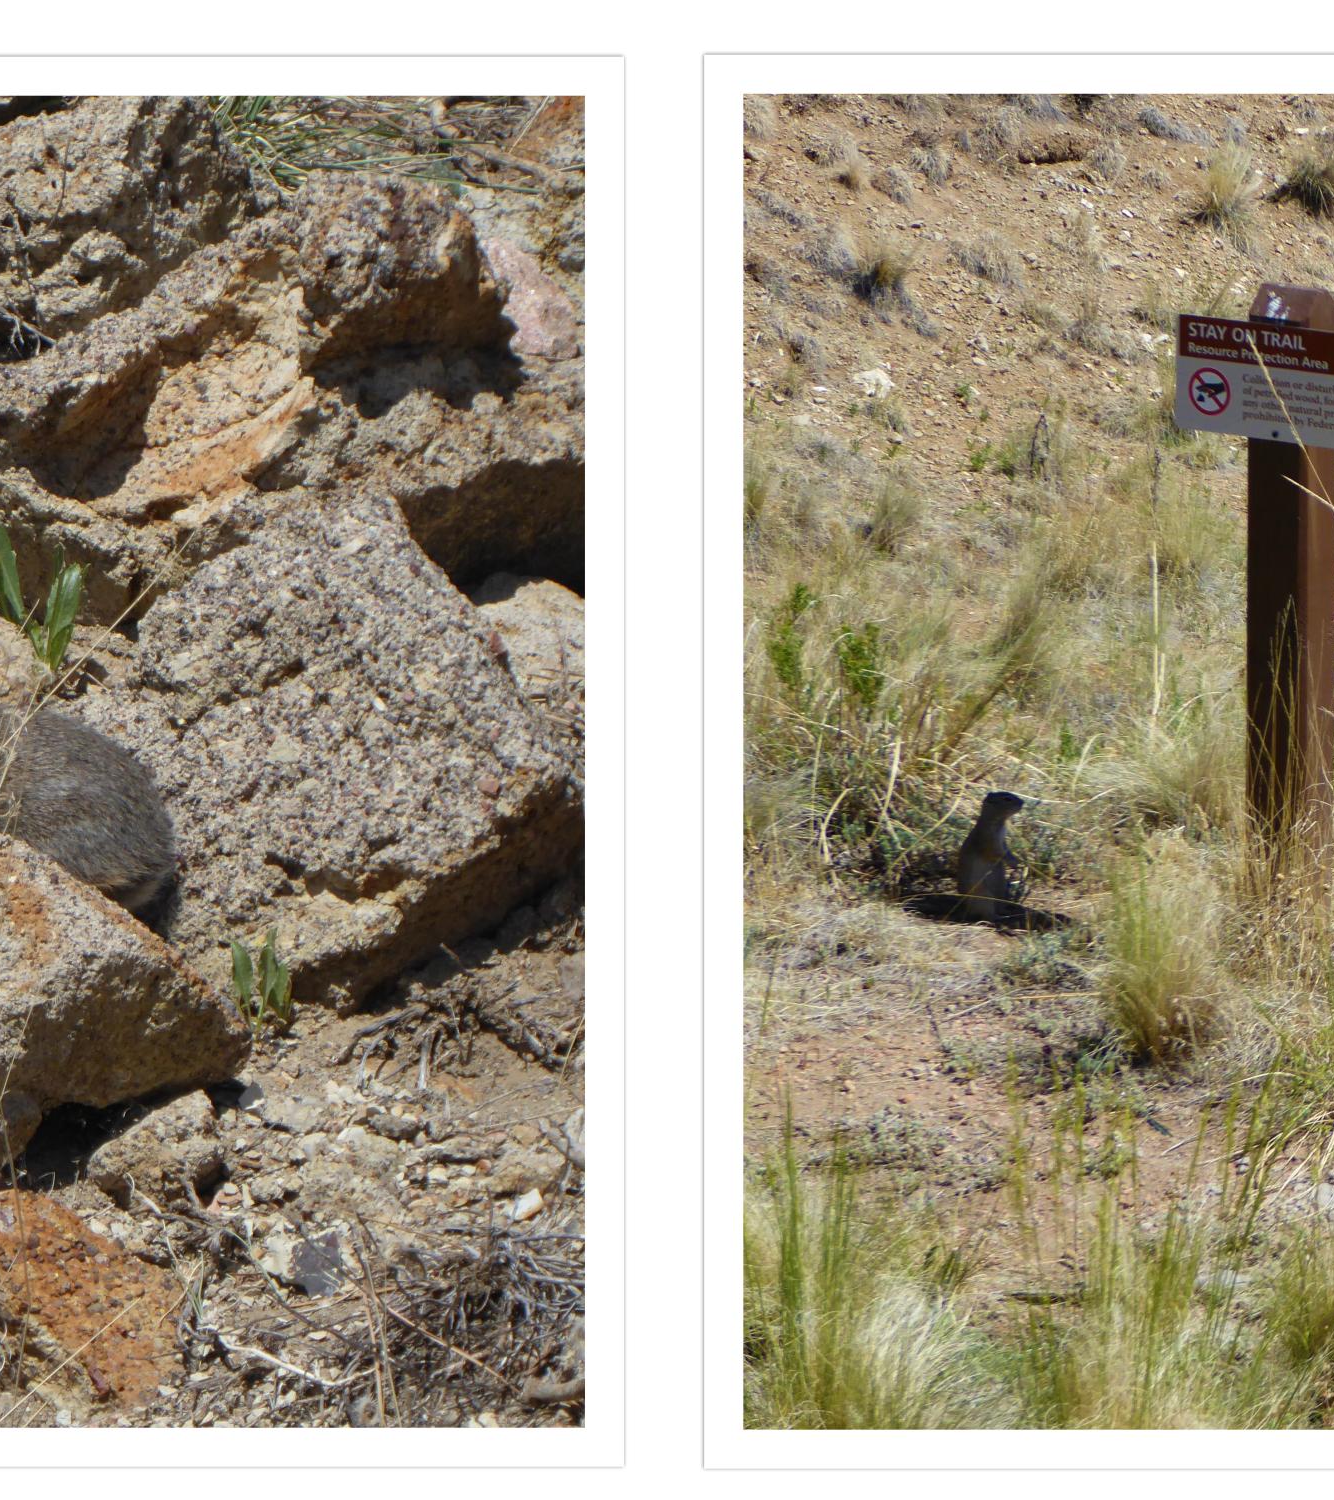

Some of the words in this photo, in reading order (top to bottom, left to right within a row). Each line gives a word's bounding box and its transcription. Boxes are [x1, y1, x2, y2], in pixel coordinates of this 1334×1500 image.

[1188, 322, 1228, 340] STAY
[1232, 327, 1257, 345] ON
[1261, 330, 1307, 351] TRAIL
[1188, 341, 1238, 359] Resource
[1302, 356, 1329, 370] Area
[1292, 382, 1303, 390] or
[1288, 405, 1322, 417] natural
